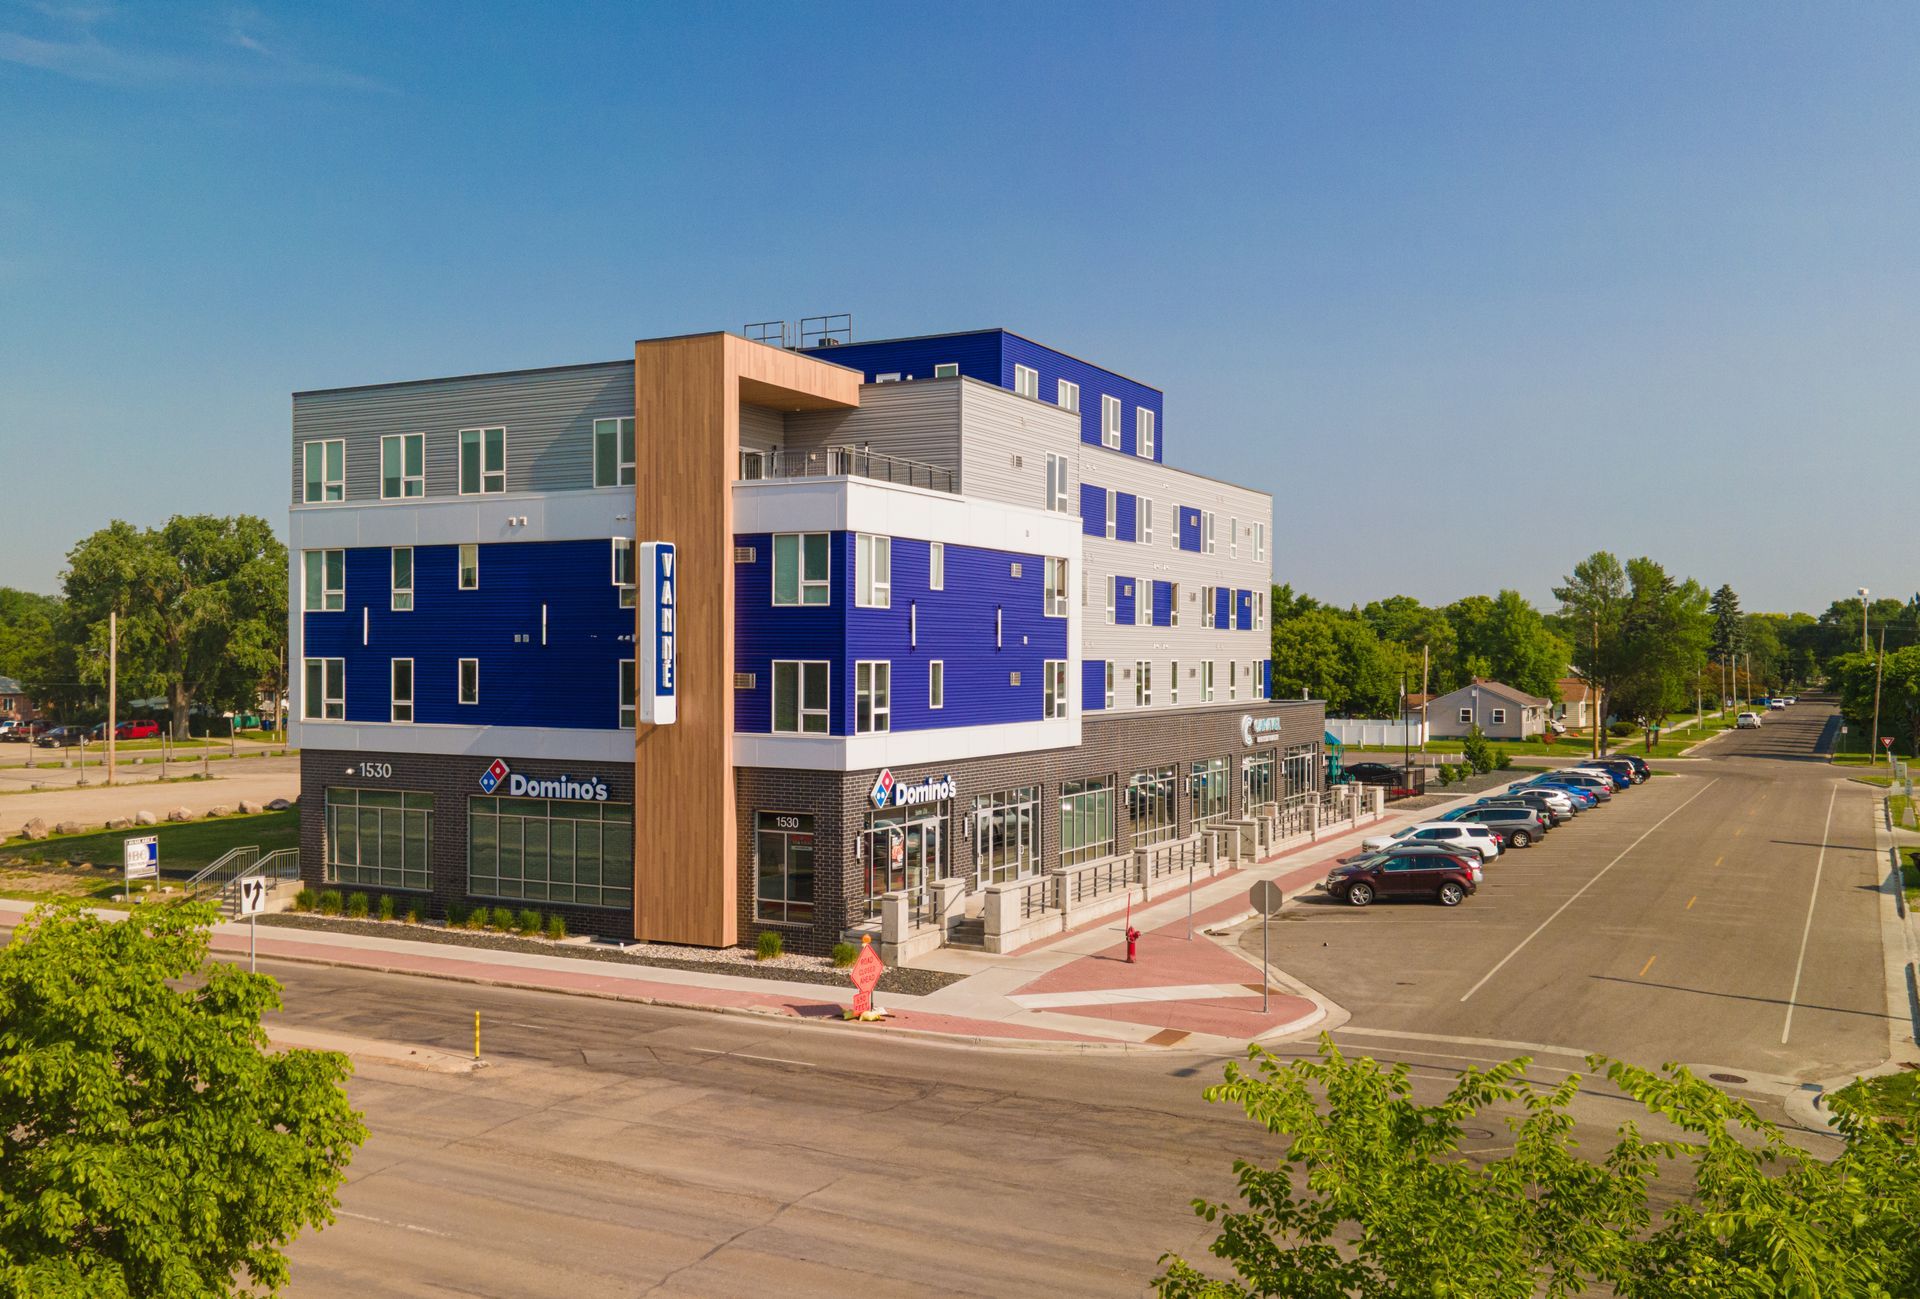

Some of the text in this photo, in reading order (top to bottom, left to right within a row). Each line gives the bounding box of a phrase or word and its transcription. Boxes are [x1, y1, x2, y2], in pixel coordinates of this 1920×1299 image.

[360, 762, 392, 778] 1530
[510, 774, 608, 801] Domino's
[895, 775, 956, 806] Domino's
[776, 816, 799, 828] 1530
[861, 957, 873, 965] ROAD
[859, 966, 875, 976] CLOSED
